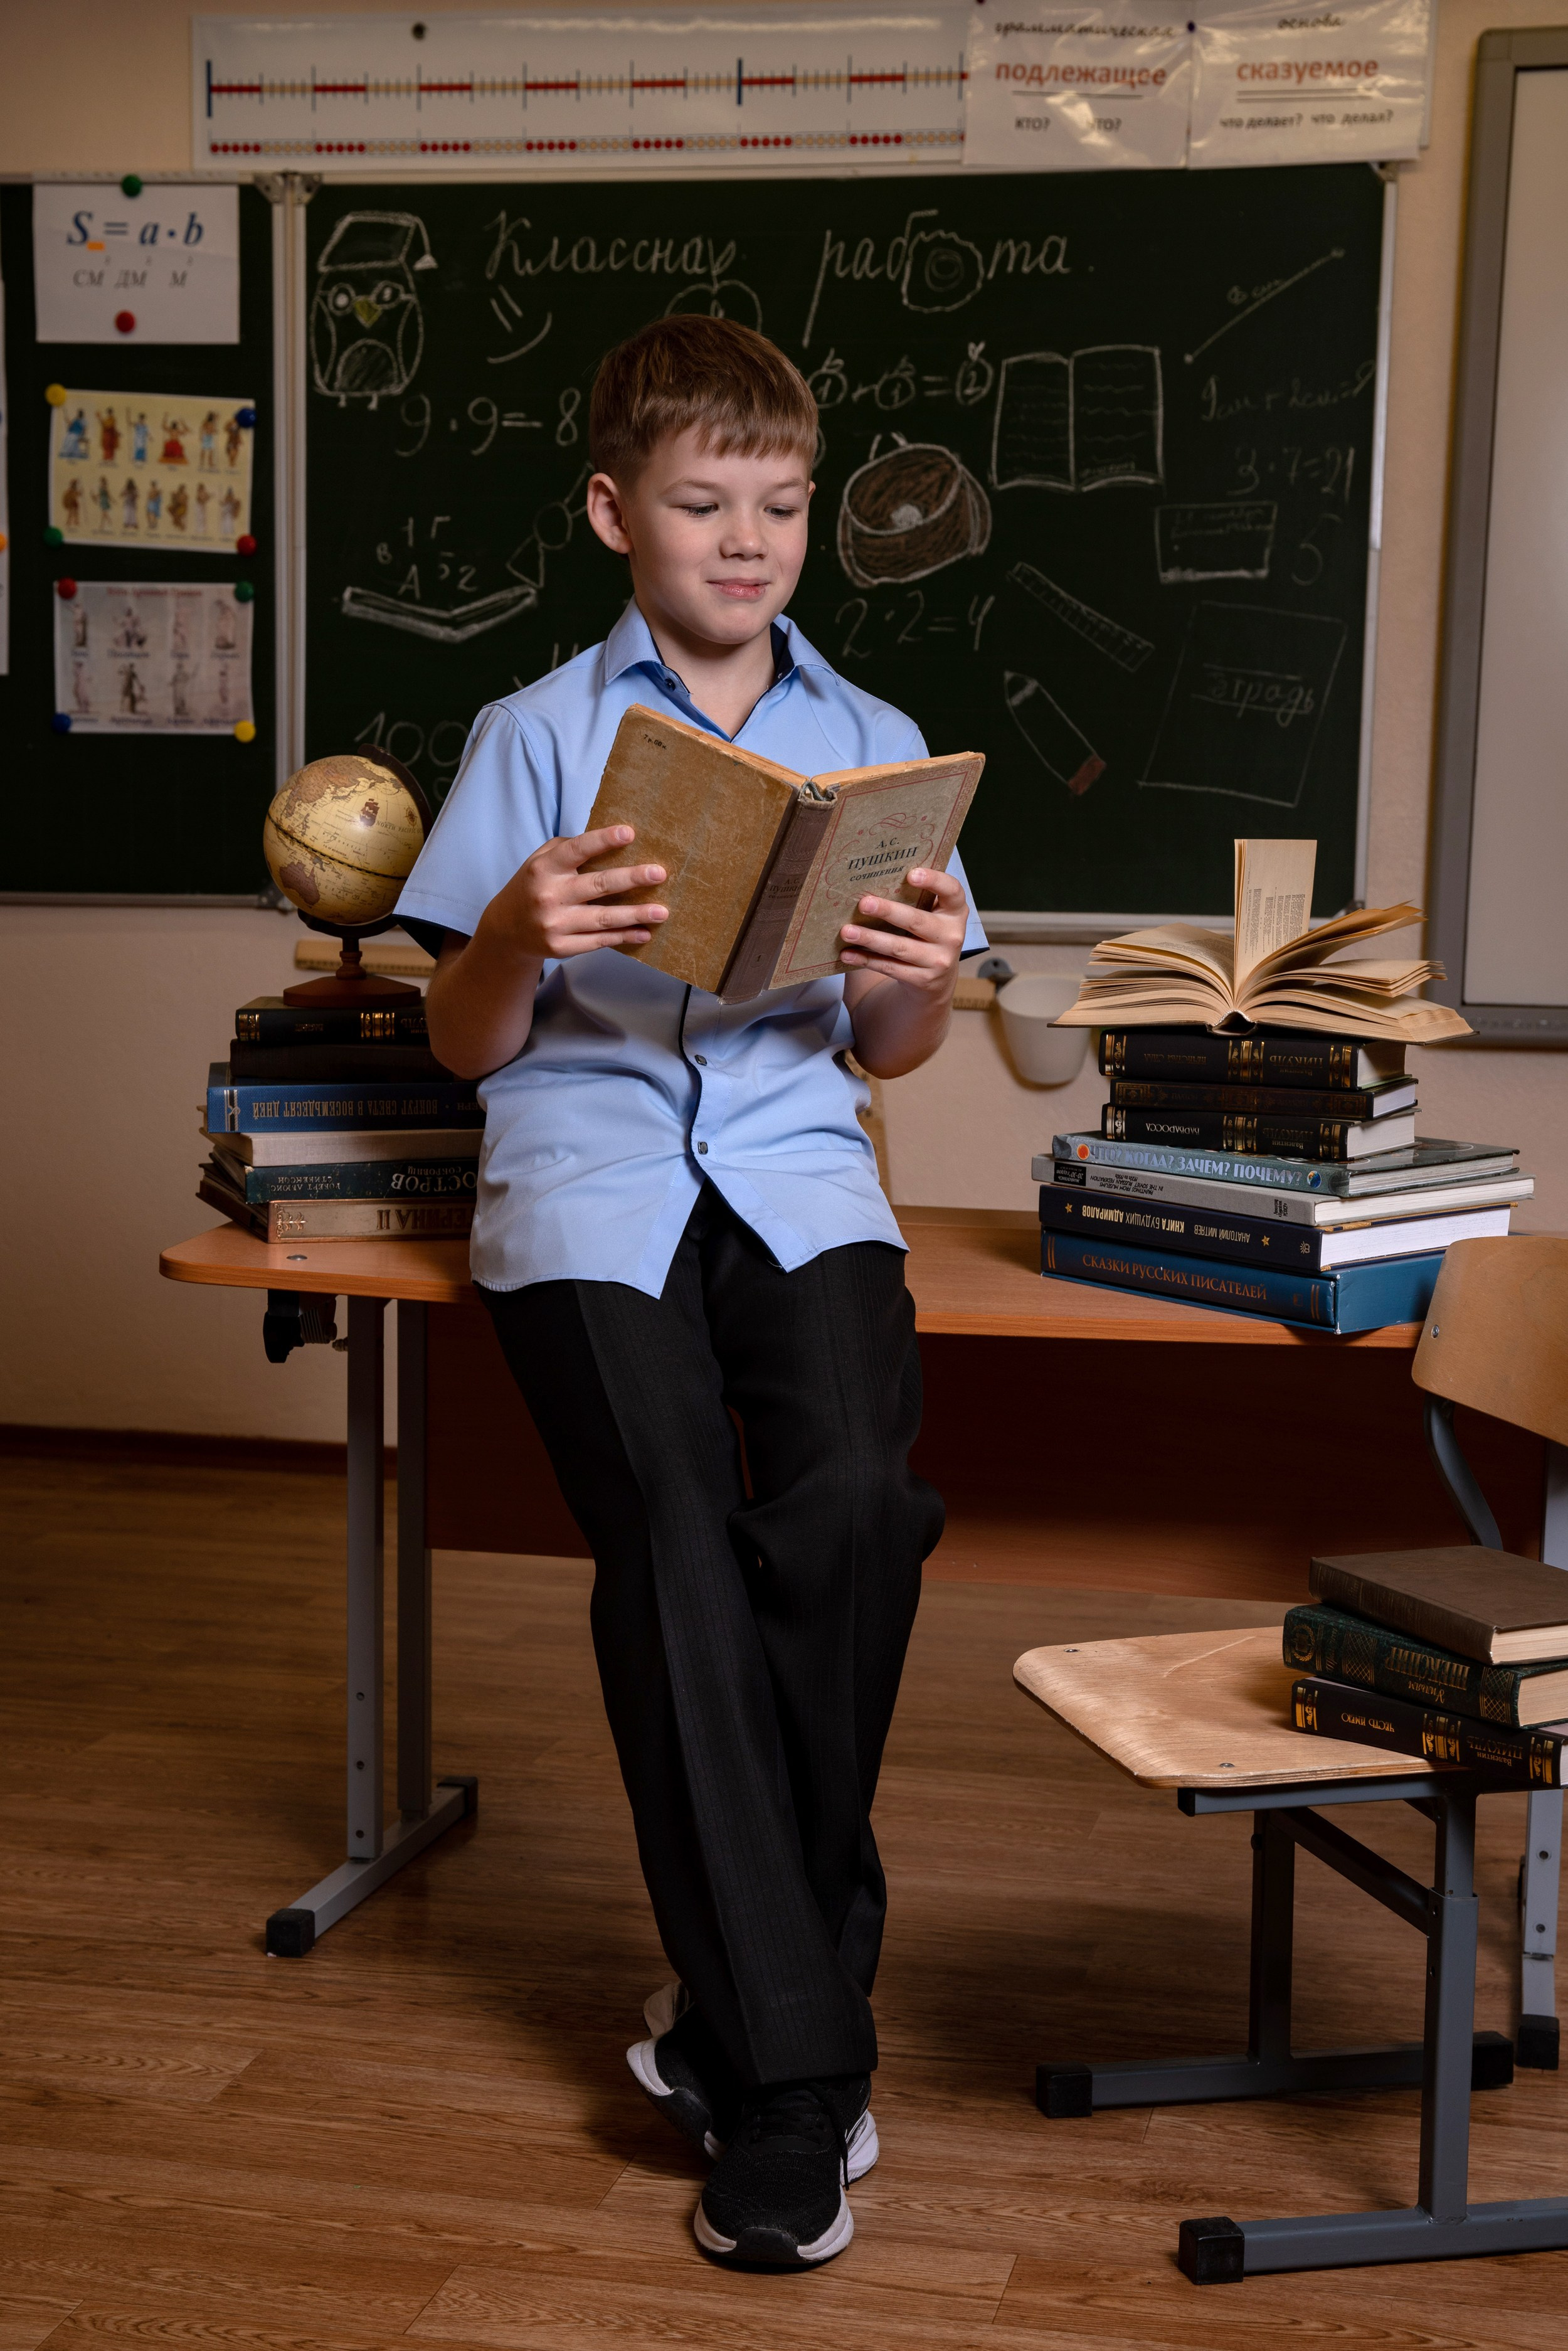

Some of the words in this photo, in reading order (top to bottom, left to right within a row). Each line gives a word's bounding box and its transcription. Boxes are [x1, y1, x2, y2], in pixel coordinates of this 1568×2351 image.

[995, 63, 1167, 88] подлежащее
[1237, 60, 1379, 85] сказуемое
[376, 820, 396, 831] NORTH
[848, 847, 918, 870] ПУШКИН
[850, 866, 904, 881] СОЧИНЕНИЯ
[1269, 1055, 1324, 1069] ПИКУЛЬ
[252, 1100, 280, 1120] ДНЕЙ
[283, 1099, 354, 1118] ВОСЕМЬДЕСЯТ
[357, 1101, 364, 1116] В
[367, 1100, 397, 1116] СВЕТА
[401, 1098, 438, 1115] ВОКРУГ
[1272, 1140, 1304, 1149] Валентин
[1127, 1149, 1174, 1169] КОГДА?
[1177, 1155, 1230, 1177] ЗАЧЕМ?
[1233, 1162, 1303, 1186] ПОЧЕМУ?
[277, 1175, 333, 1184] СТИВЕНСОН
[307, 1182, 341, 1191] РОБЕРТ
[390, 1171, 478, 1193] ОСТРОВ
[1090, 1176, 1115, 1184] FEDERATION
[1131, 1187, 1153, 1195] PAINTINGS
[1082, 1204, 1124, 1223] АДМИРАЛОВ
[1125, 1212, 1160, 1229] БУДУЩИХ
[1161, 1218, 1185, 1233] КНИГА
[1194, 1224, 1217, 1237] МИТЯЕВ
[1219, 1228, 1250, 1243] АНАТОЛИЙ
[1082, 1254, 1130, 1275] СКАЗКИ
[1131, 1263, 1188, 1285] РУССКИХ
[1191, 1274, 1268, 1300] ПИСАТЕЛЕЙ
[1384, 1646, 1471, 1691] ШЕКСПИР
[1407, 1680, 1445, 1704] Уильям
[1341, 1712, 1367, 1727] ИМЕЮ
[1368, 1718, 1395, 1733] ЧЕСТЬ
[1466, 1735, 1524, 1761] ПИКУЛЬ
[1476, 1752, 1513, 1766] Валентин
